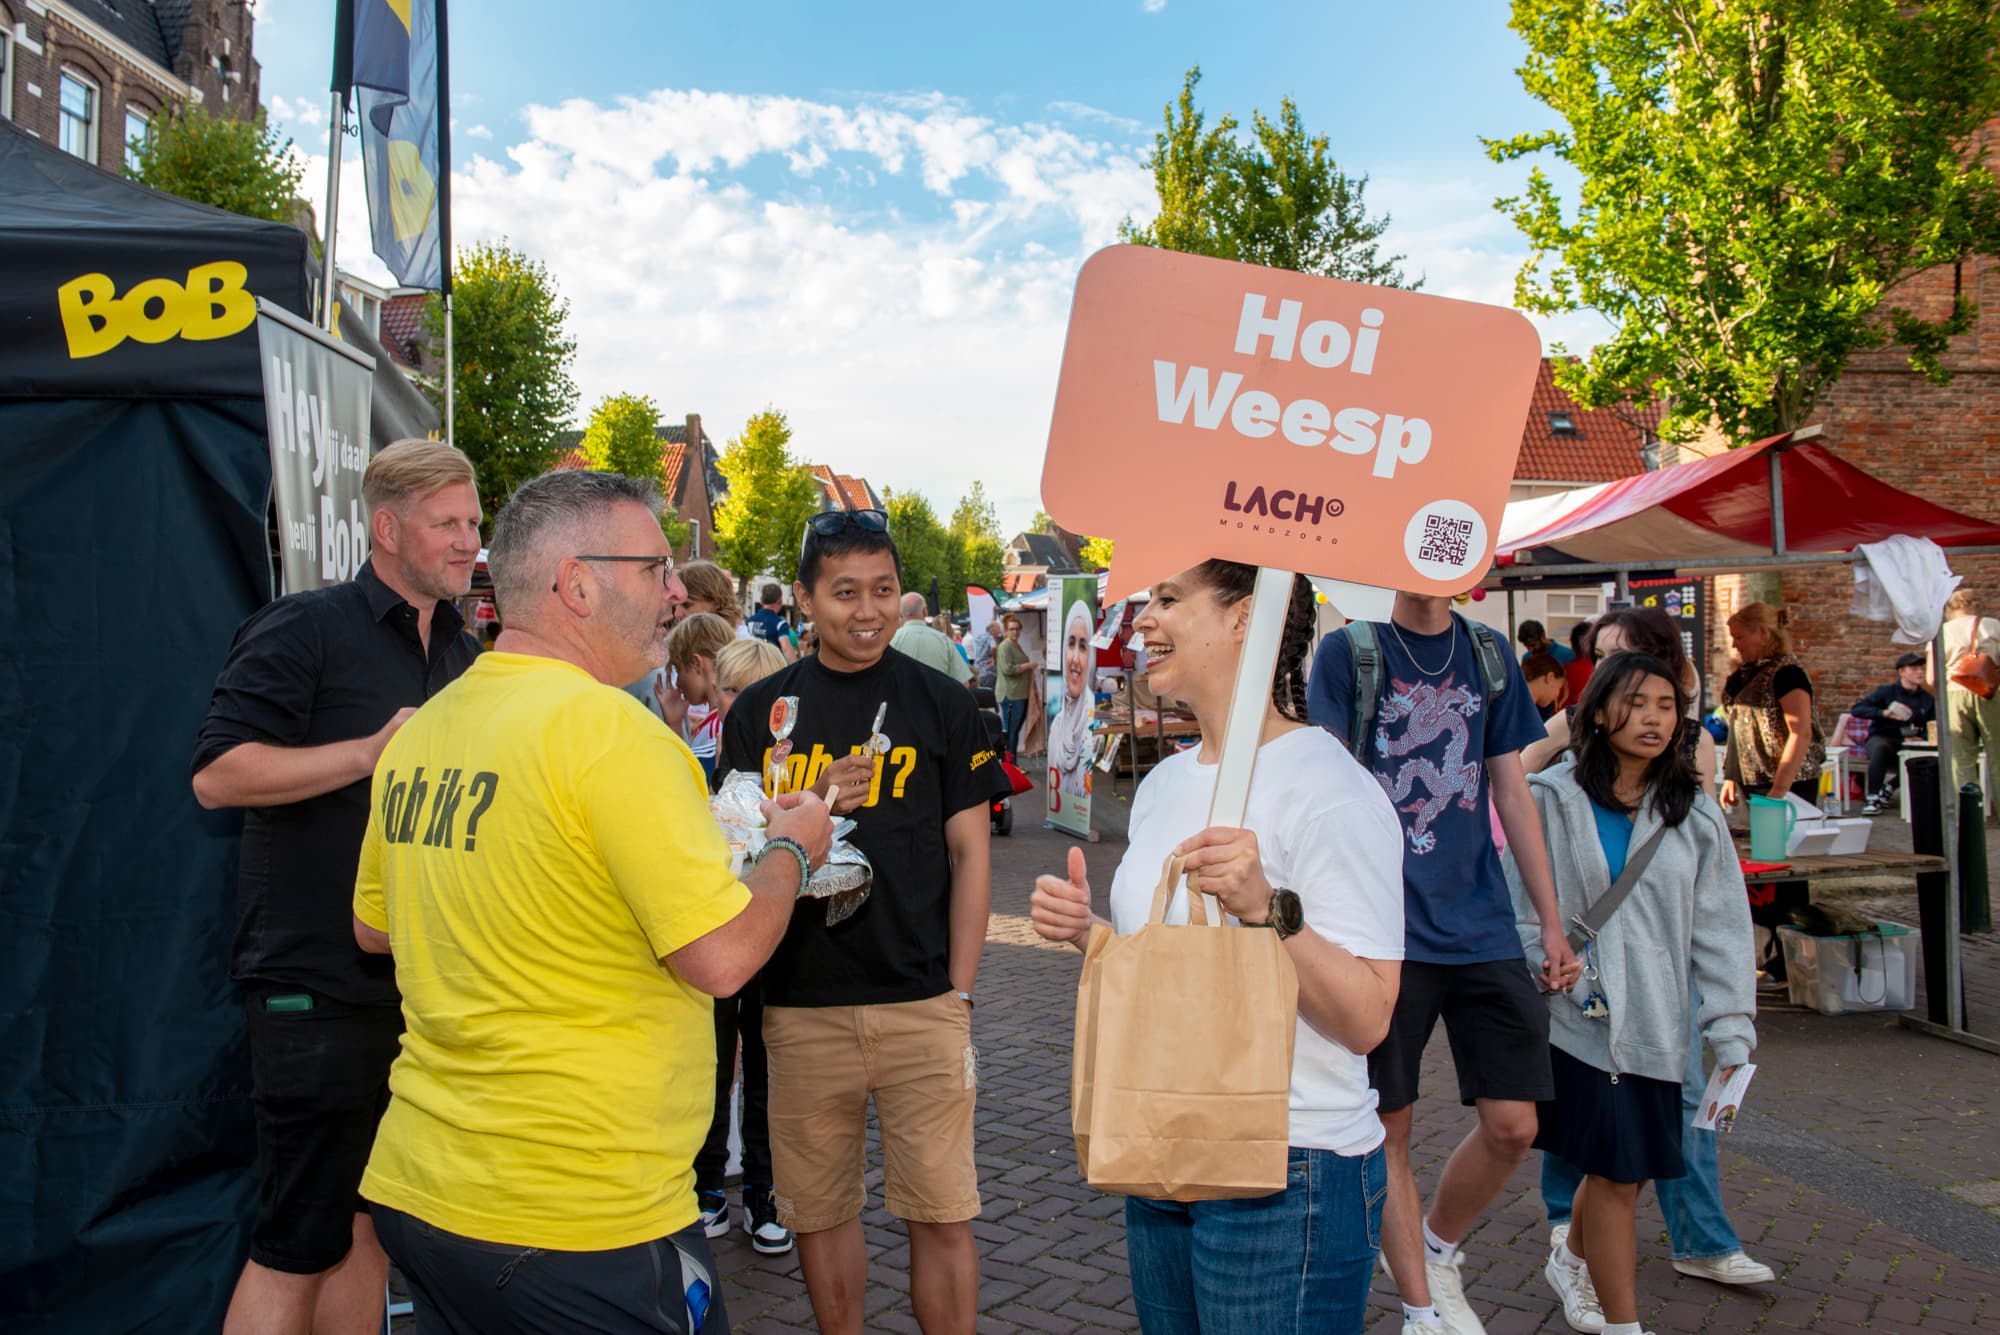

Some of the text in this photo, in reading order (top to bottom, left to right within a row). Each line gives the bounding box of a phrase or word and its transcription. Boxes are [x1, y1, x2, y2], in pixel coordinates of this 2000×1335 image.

[1234, 292, 1385, 375] Hoi
[273, 355, 327, 488] Hey
[1153, 359, 1432, 479] Weesp
[288, 510, 307, 551] ben
[1219, 519, 1338, 545] MONDZORG
[422, 768, 499, 852] ik?
